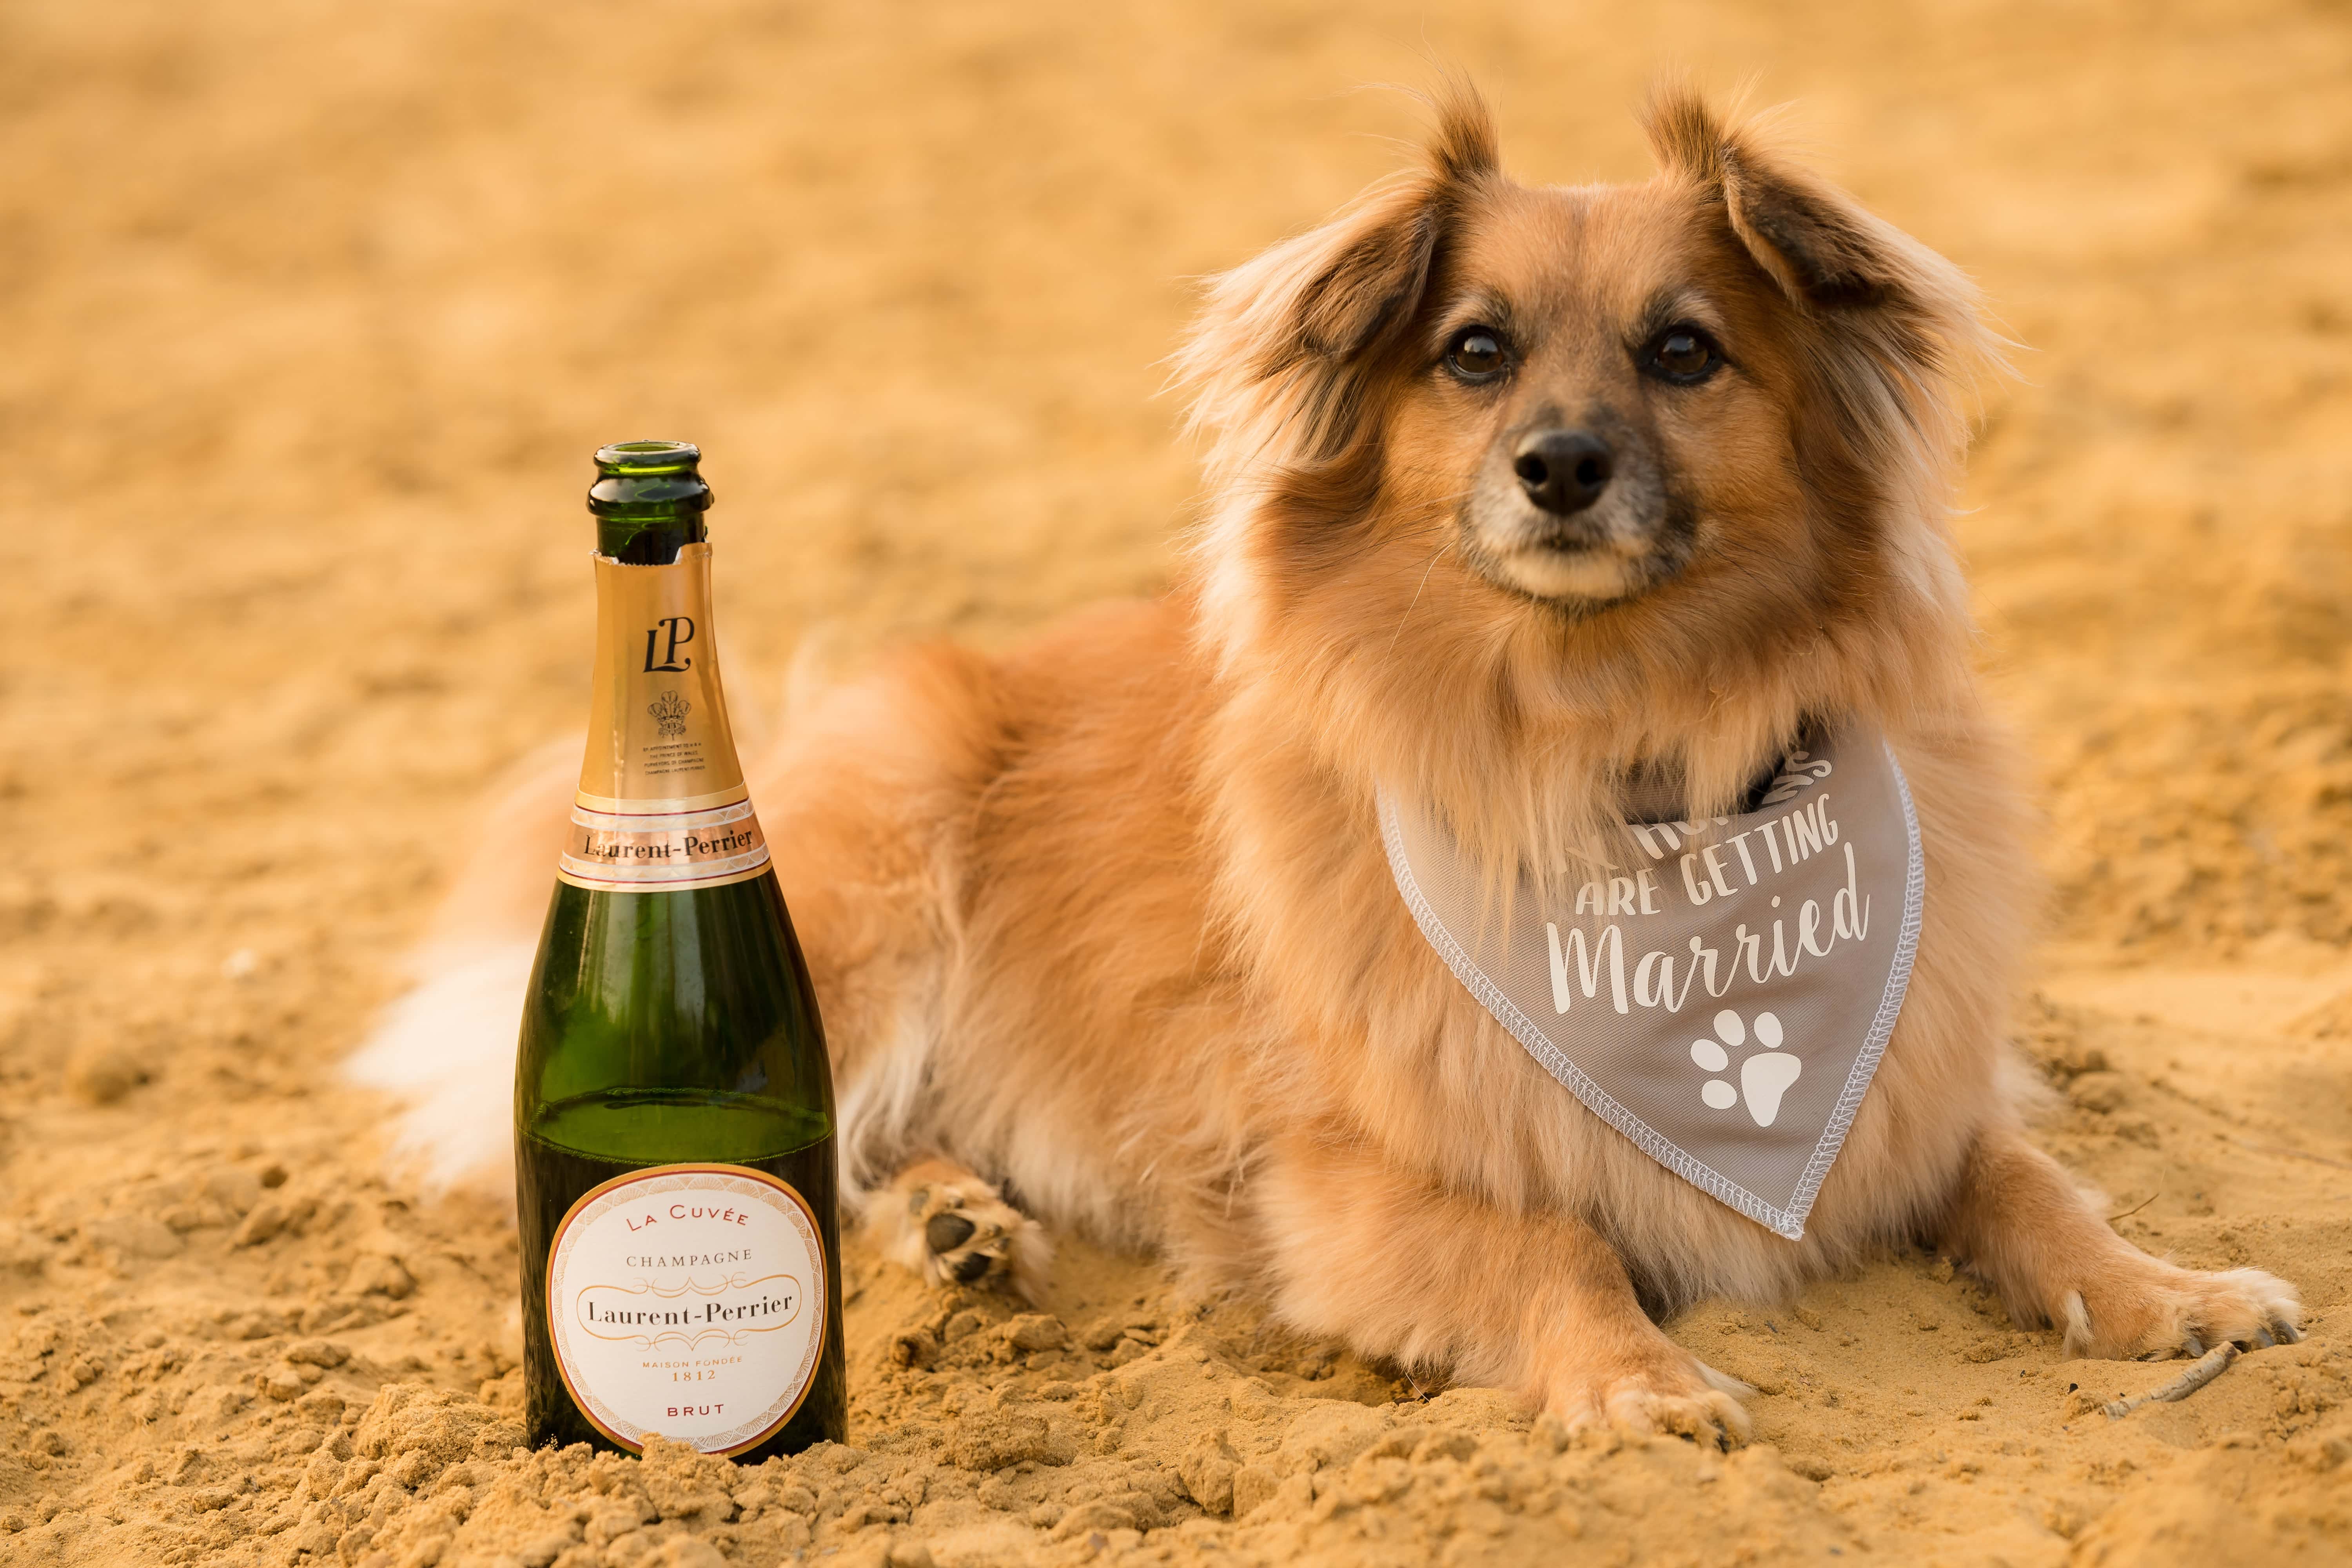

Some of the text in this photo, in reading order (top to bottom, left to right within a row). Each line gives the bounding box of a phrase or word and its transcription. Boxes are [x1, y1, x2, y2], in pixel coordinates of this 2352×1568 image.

[584, 830, 752, 859] Laurent-Perrier
[1575, 868, 1661, 915] ARE
[1681, 794, 1838, 906] GETTING
[1546, 842, 1870, 1014] Married
[626, 1215, 657, 1231] LA
[626, 1249, 751, 1267] CHAMPAGNE
[587, 1296, 792, 1325] Laurent-Perrier
[696, 1356, 743, 1367] FONDÉE
[672, 1370, 715, 1382] 1812
[667, 1404, 724, 1417] BRUT
